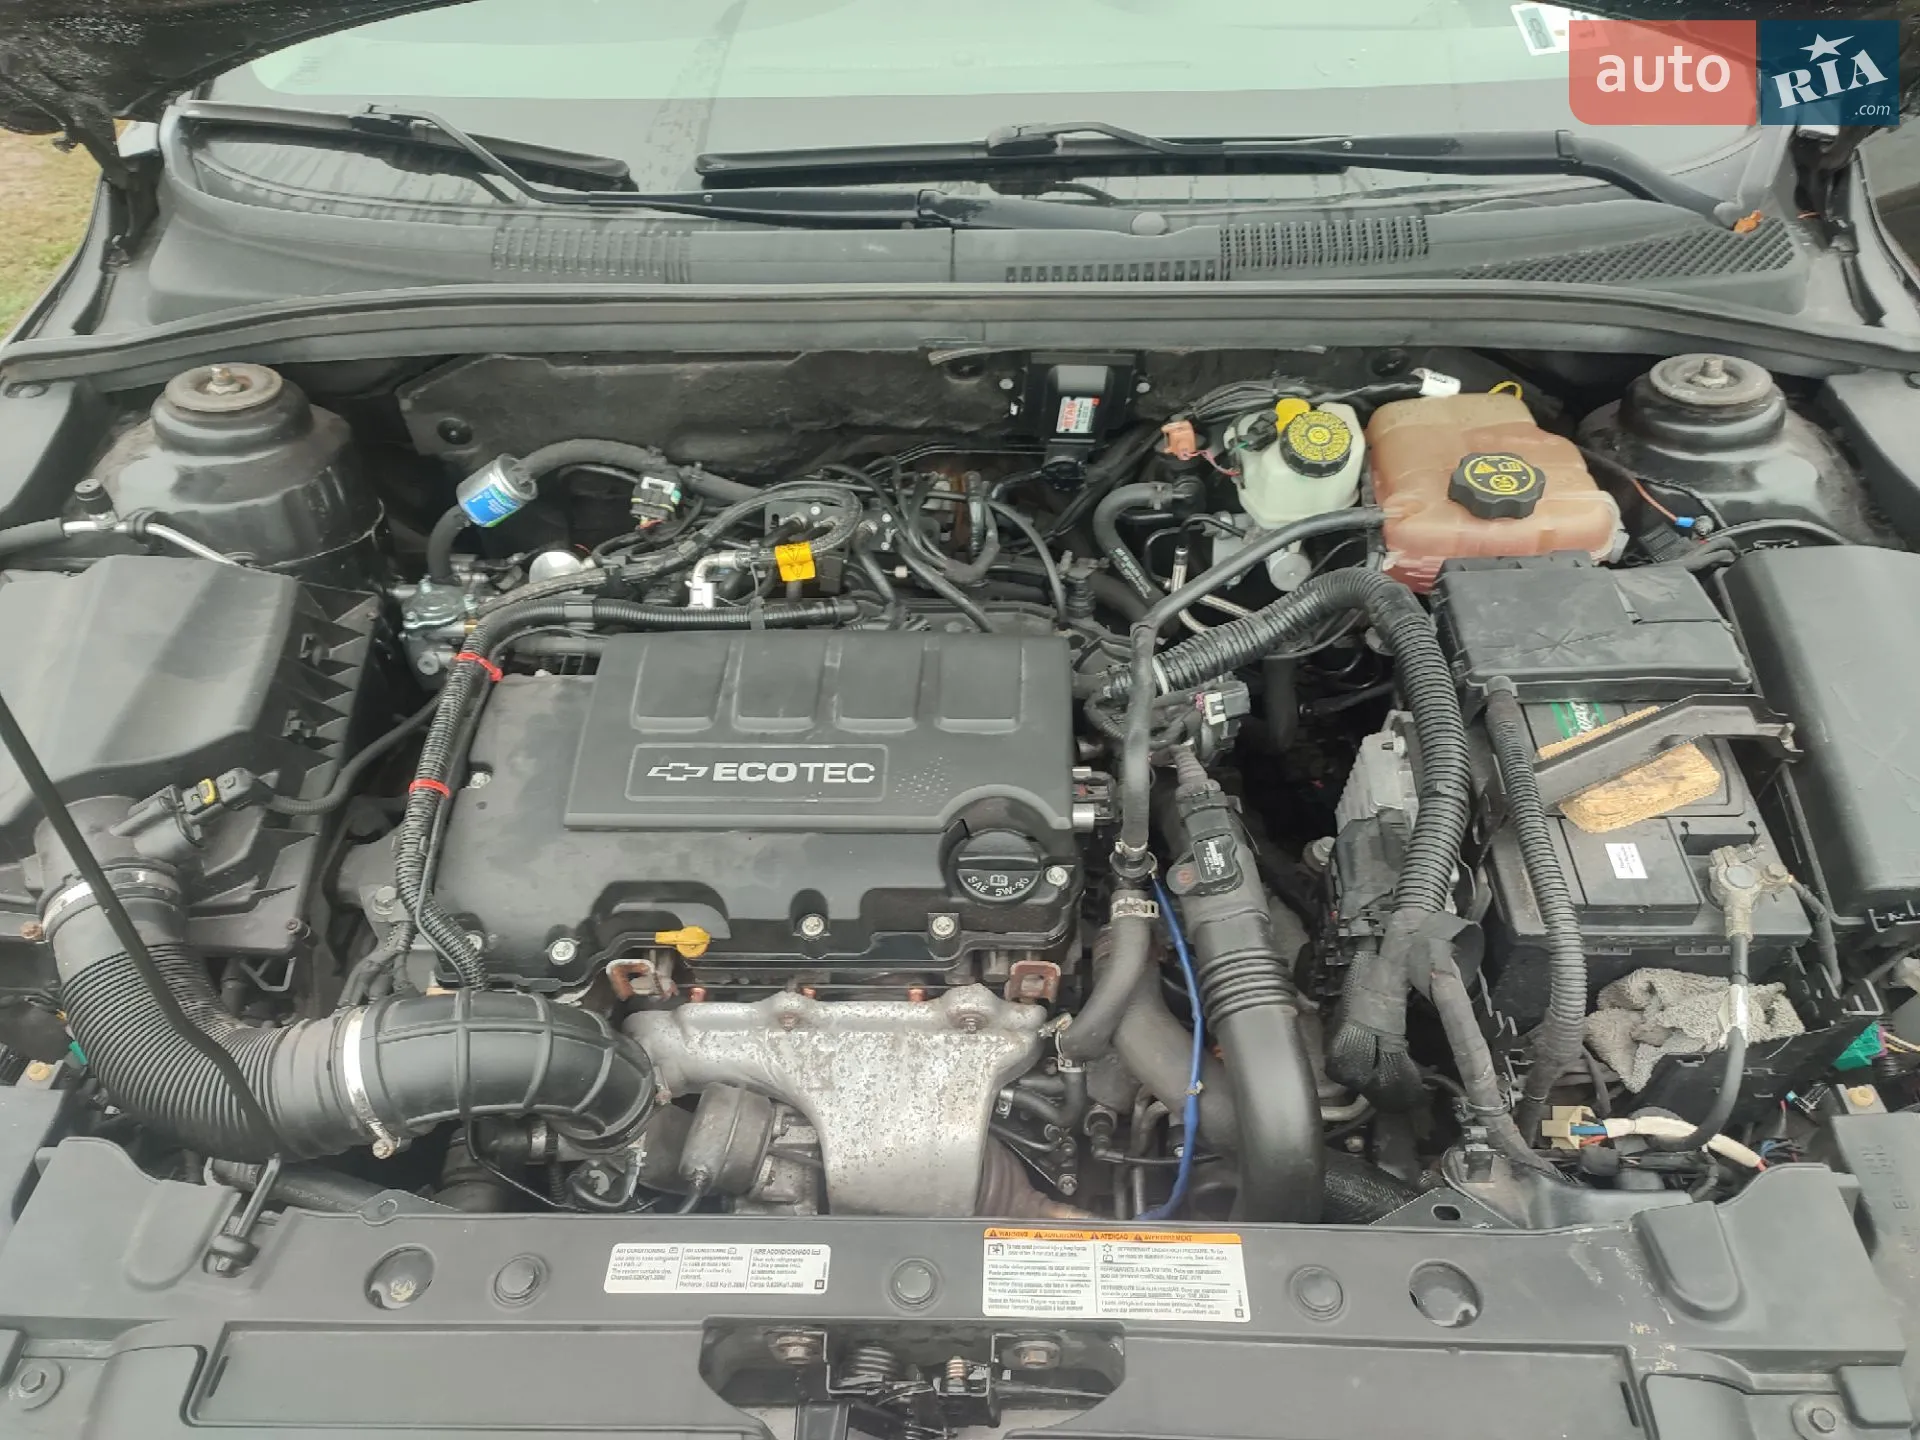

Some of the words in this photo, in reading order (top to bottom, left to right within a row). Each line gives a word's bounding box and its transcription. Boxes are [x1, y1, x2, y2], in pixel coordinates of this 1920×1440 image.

[713, 762, 875, 783] ECOTEC
[967, 875, 989, 893] SAE
[995, 877, 1030, 897] 5W-30
